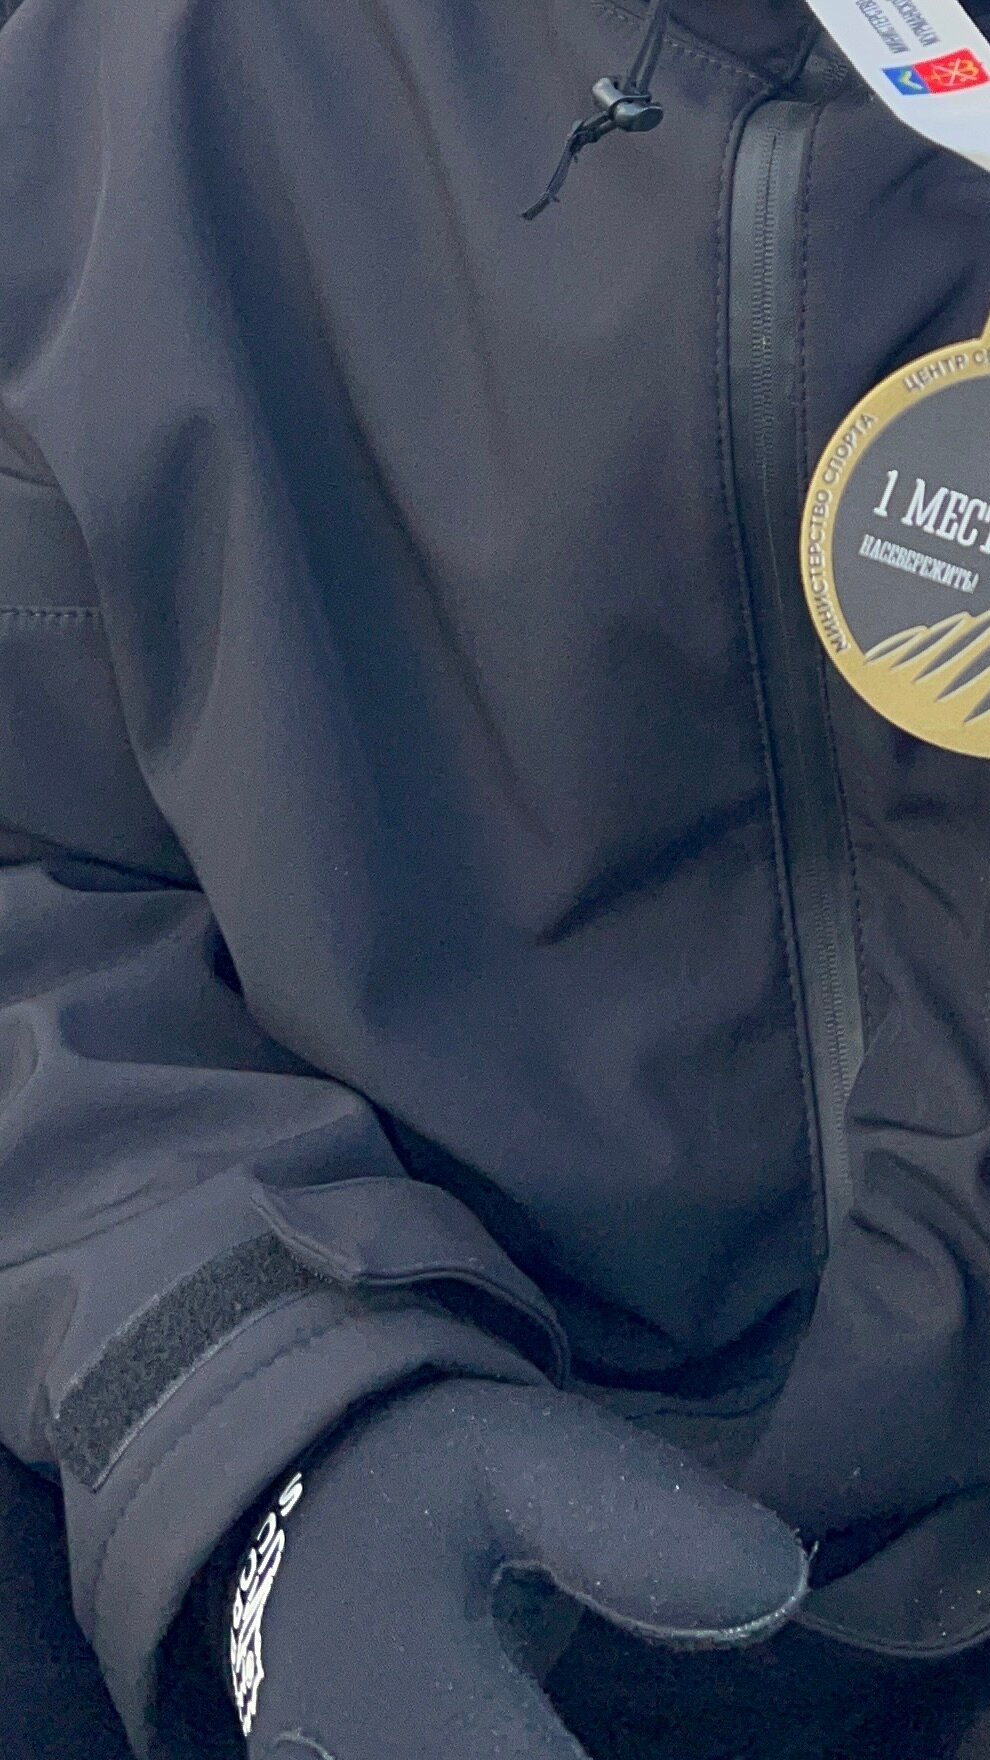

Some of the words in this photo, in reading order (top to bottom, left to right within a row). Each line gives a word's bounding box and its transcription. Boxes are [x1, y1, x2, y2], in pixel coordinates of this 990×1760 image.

[902, 351, 969, 392] ЦЕНТР
[823, 412, 878, 485] СПОРТА
[874, 469, 899, 518] 1
[808, 488, 851, 653] МИНИСТЕРСТВО
[858, 533, 980, 595] НАСЕВЕРЕЖИТЬ!
